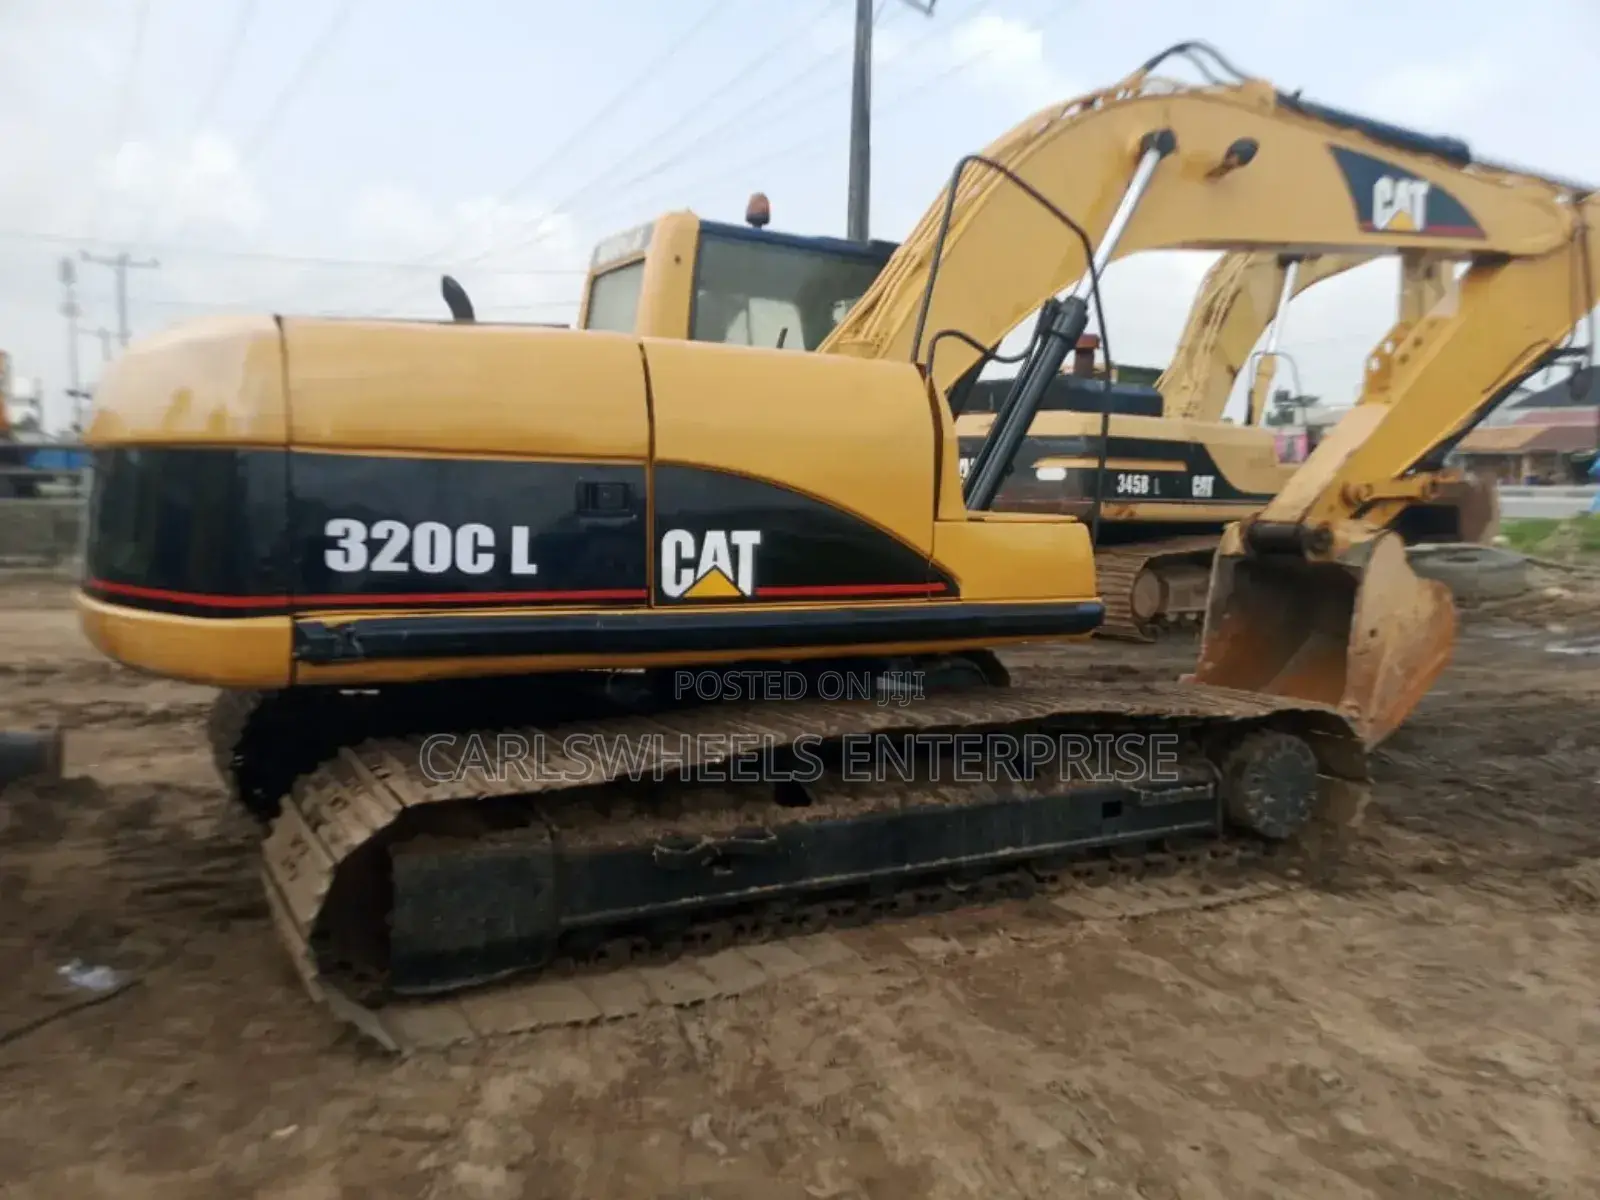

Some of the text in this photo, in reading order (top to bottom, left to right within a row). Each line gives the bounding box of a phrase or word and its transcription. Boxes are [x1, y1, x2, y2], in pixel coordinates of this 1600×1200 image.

[1373, 175, 1430, 231] CAT
[1117, 473, 1149, 494] 345B
[1192, 474, 1215, 497] CAT
[324, 518, 538, 575] 320C L
[661, 529, 762, 598] CAT
